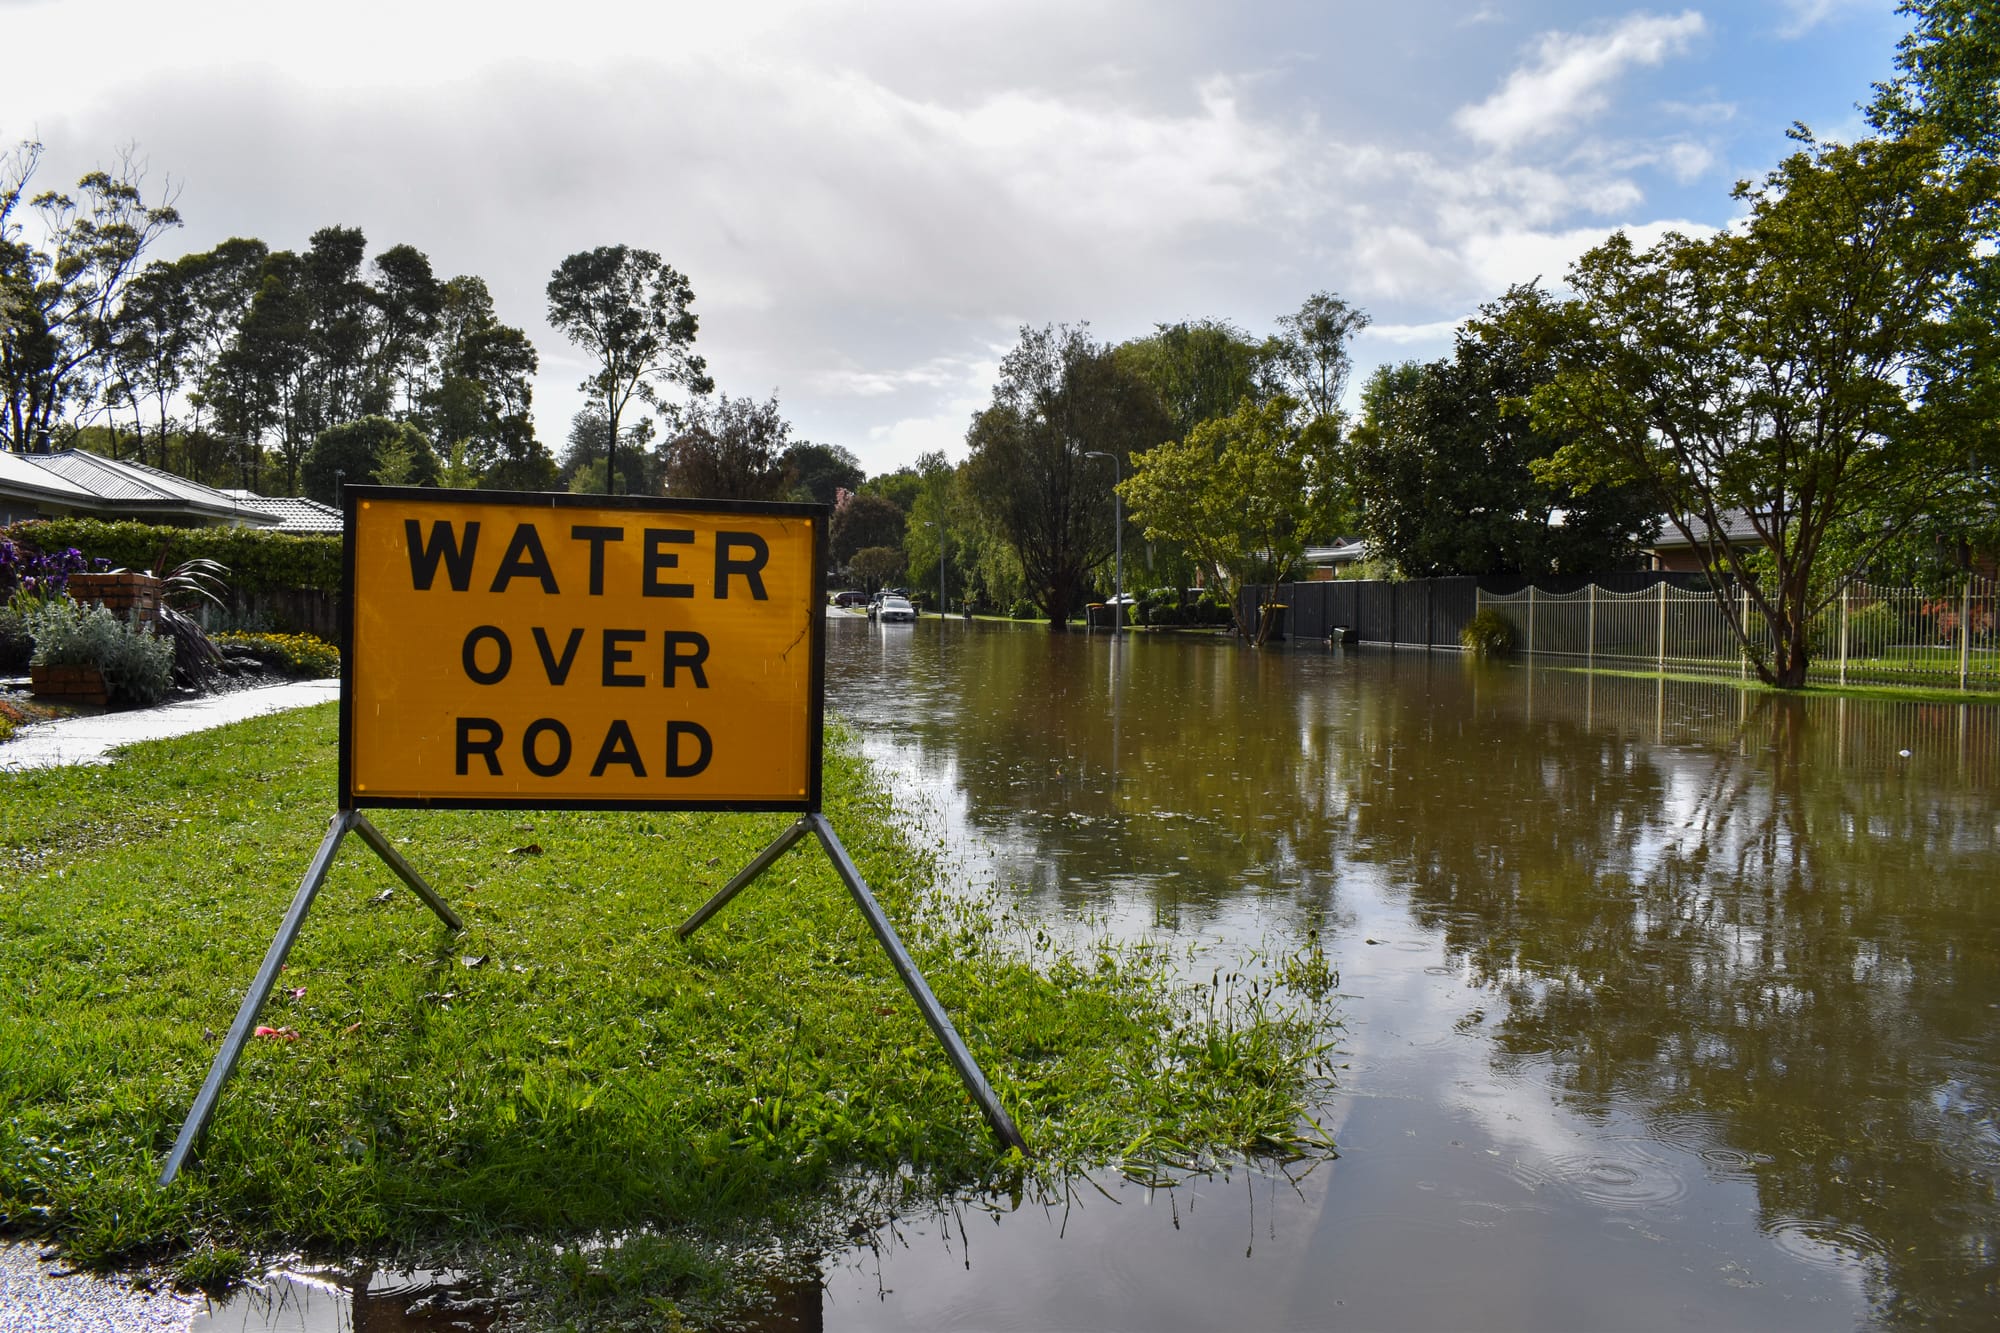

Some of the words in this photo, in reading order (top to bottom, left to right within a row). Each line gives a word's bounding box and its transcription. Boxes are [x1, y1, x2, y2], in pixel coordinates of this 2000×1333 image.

[405, 519, 770, 600] WATER
[462, 625, 710, 688] OVER
[456, 717, 713, 778] ROAD
